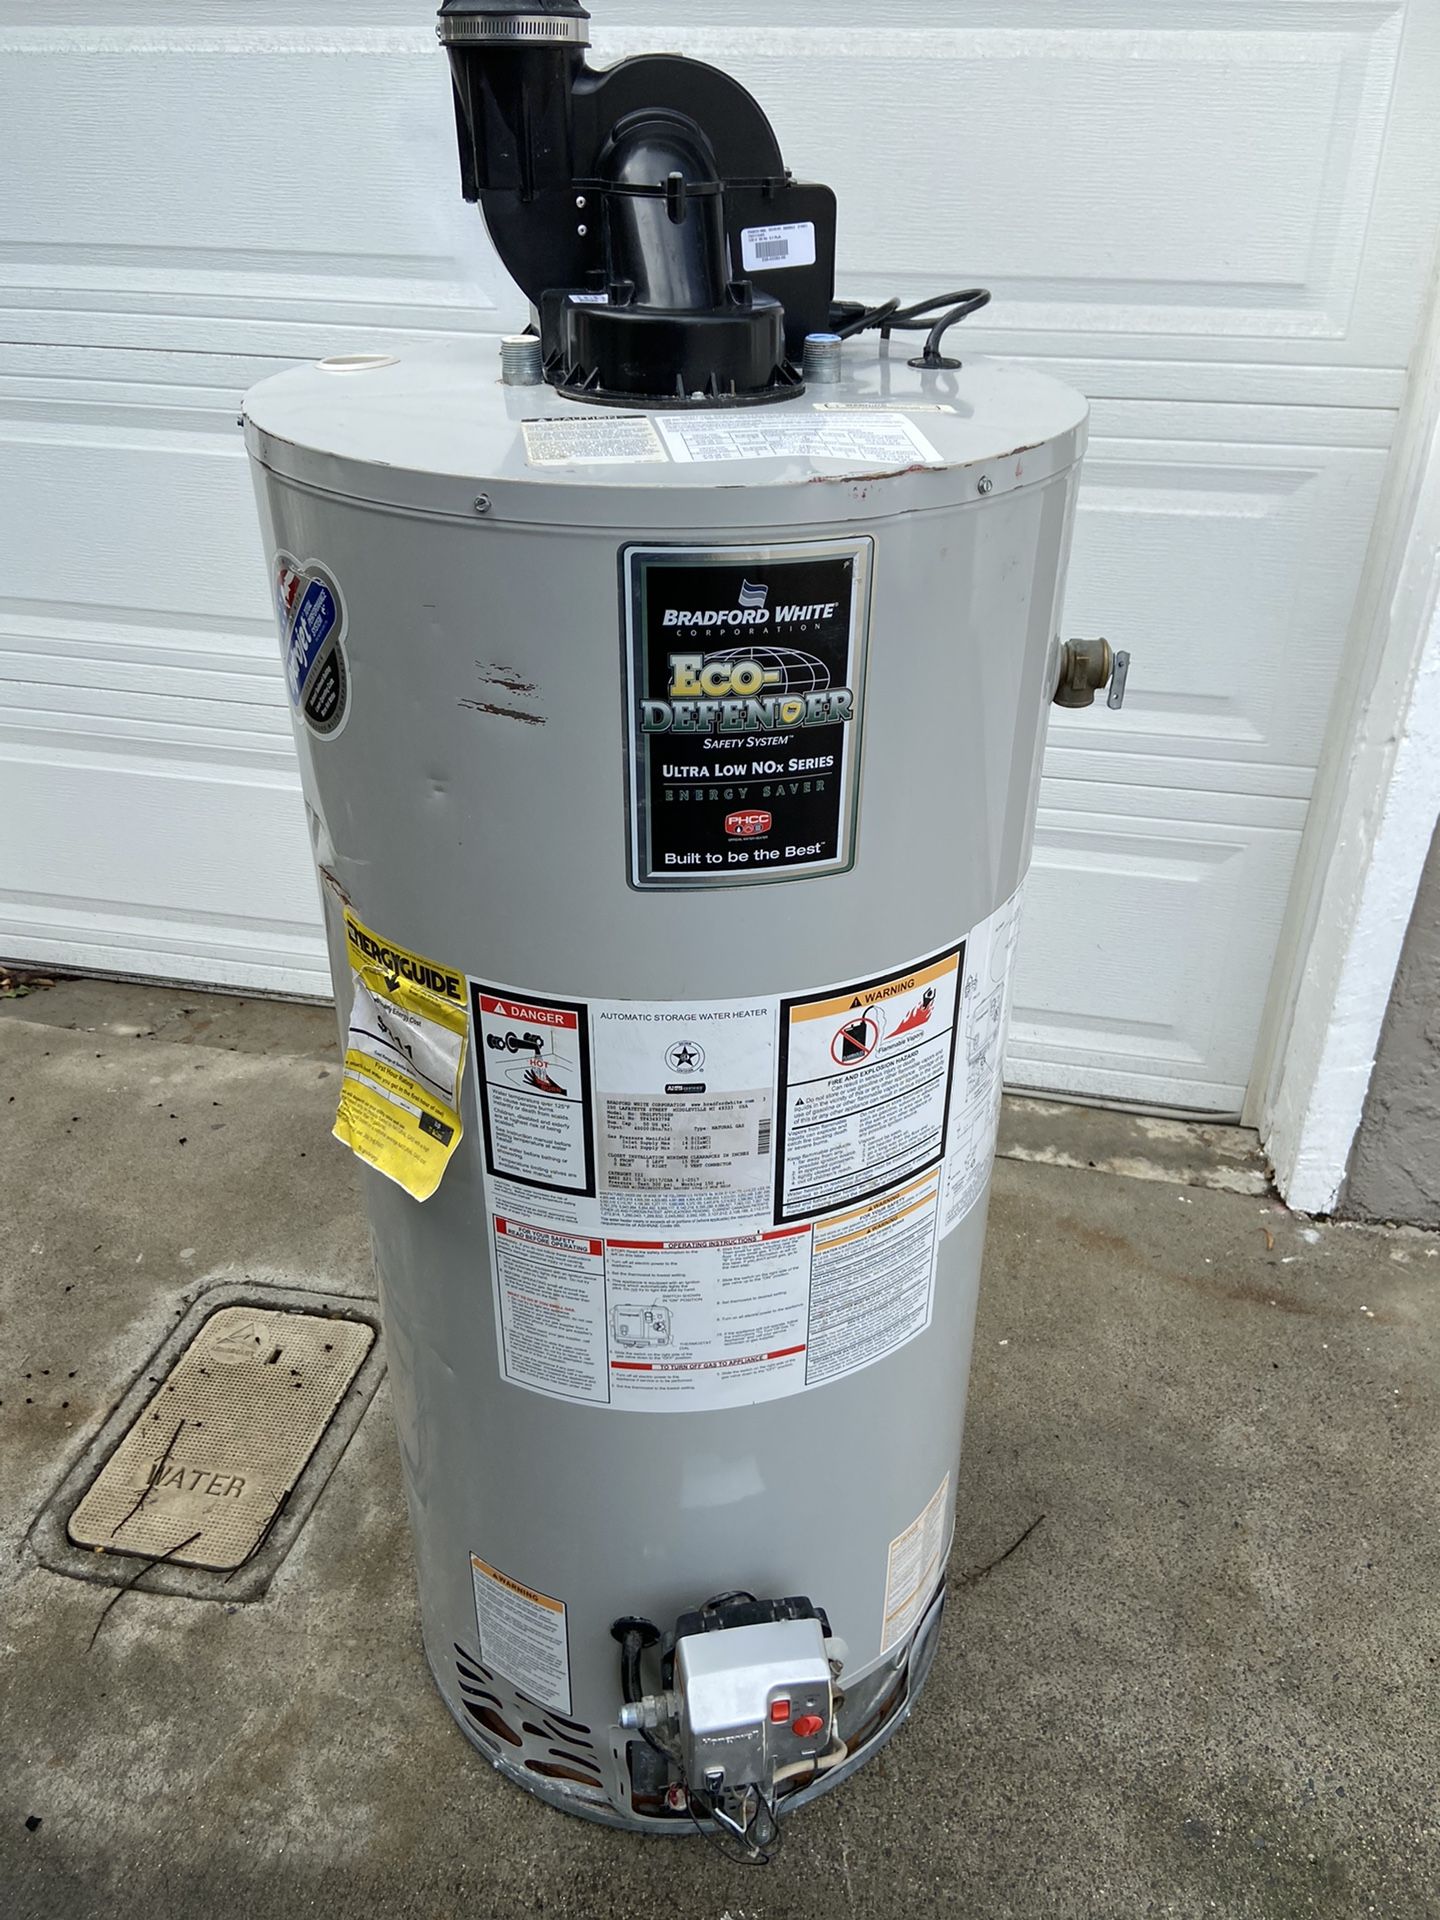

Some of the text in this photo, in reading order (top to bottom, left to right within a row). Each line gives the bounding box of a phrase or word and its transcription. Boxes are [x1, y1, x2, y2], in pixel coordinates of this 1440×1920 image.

[662, 602, 836, 626] BRADFORD WHITE
[676, 622, 821, 637] CORPORATION
[640, 687, 854, 734] DEFENDER
[703, 735, 789, 749] SAFETY SYSTEM
[662, 764, 710, 778] ULTRA
[714, 763, 747, 777] LOW
[788, 755, 834, 772] SERIES
[665, 779, 825, 801] ENERGY SAVER
[728, 814, 770, 825] PHCC
[664, 843, 822, 865] Built to be the Best
[865, 978, 916, 1004] WARNING
[511, 1006, 565, 1024] DANGER
[600, 1008, 768, 1022] AUTOMATIC STORAGE WATER HEATER
[878, 1031, 925, 1054] Flammable Vapors
[529, 1059, 550, 1069] HOT
[827, 1050, 919, 1087] FIRE AND EXPLOSION HAZARD
[507, 1228, 588, 1252] READ BEFORE OPERATING
[518, 1226, 576, 1244] FOR YOUR SAFETY
[668, 1235, 757, 1249] OPERATING INSTRUCTIONS
[148, 1462, 246, 1500] WATER
[500, 1577, 539, 1602] WARNING
